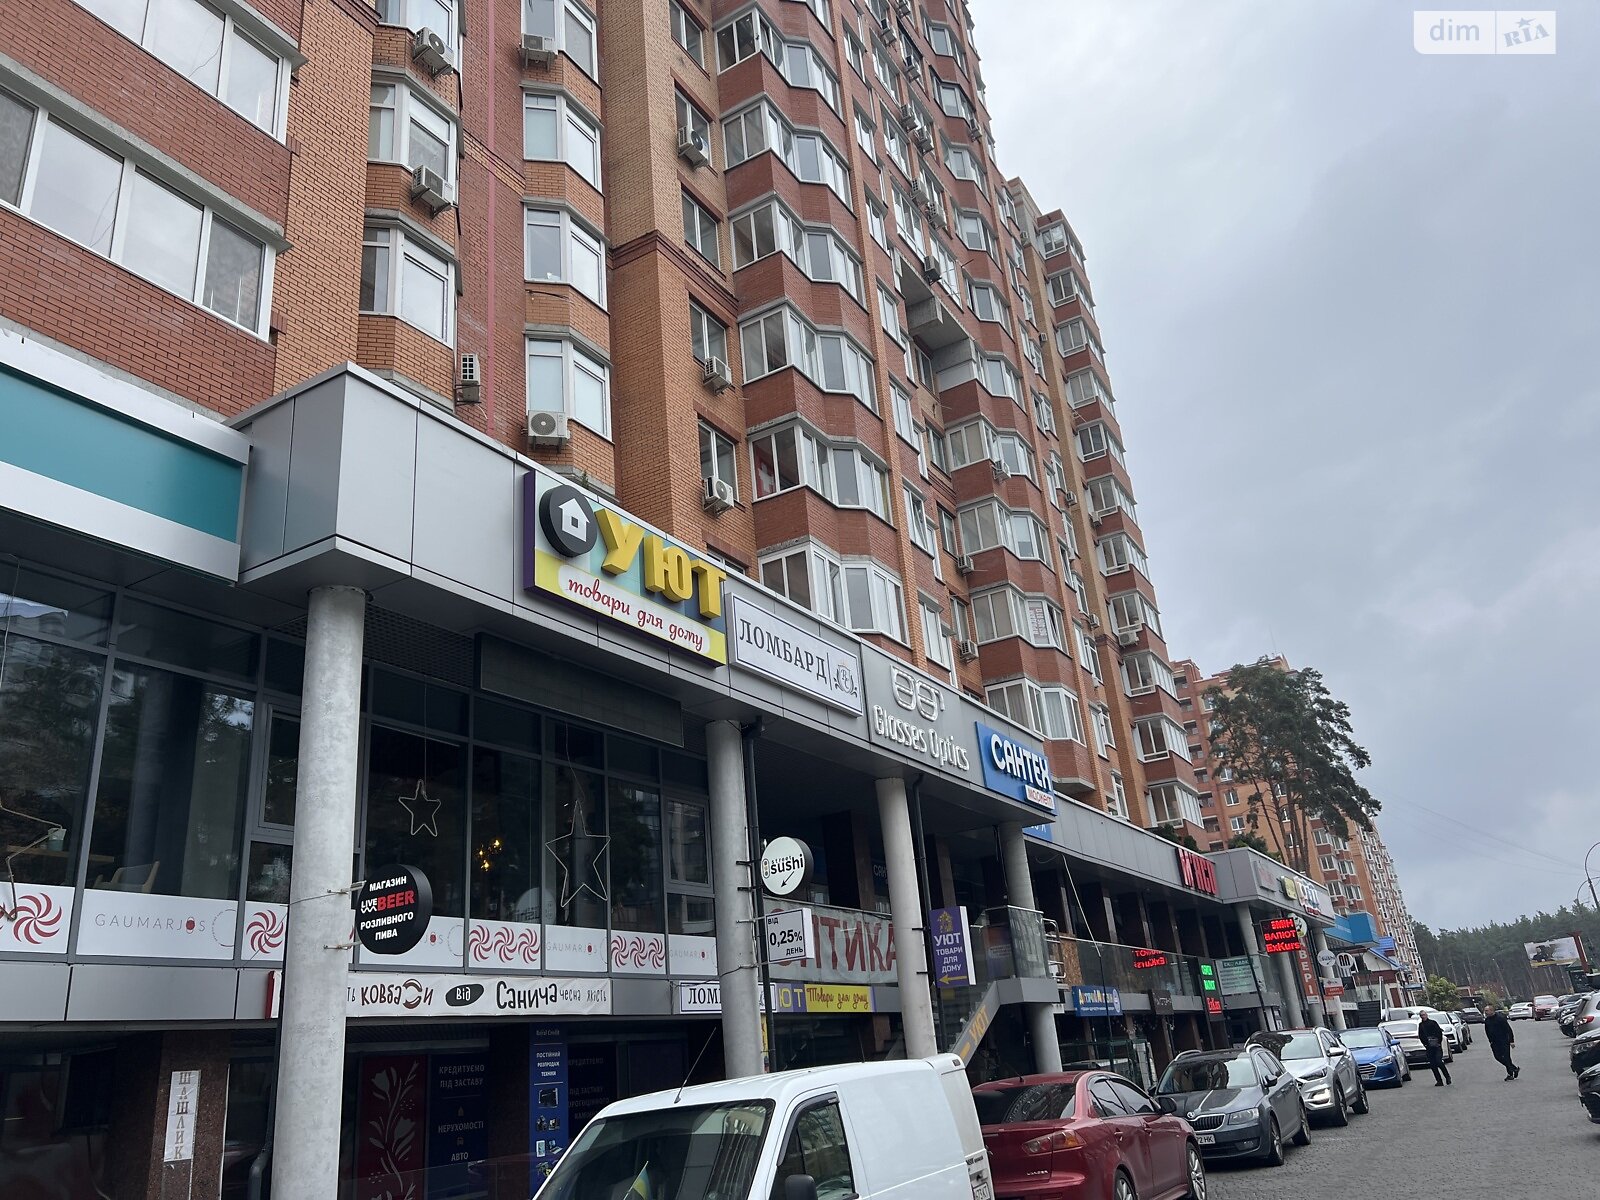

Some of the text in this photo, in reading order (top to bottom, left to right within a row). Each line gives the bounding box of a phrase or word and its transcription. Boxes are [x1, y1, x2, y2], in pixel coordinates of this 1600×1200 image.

[595, 508, 727, 620] УЮТ
[568, 576, 703, 652] товари для дому
[739, 618, 828, 683] ЛОМБАРД
[873, 704, 970, 771] Glasses Optics
[991, 734, 1052, 791] САНТЕХ
[771, 854, 804, 875] sushi
[369, 876, 407, 891] МАГАЗИН
[361, 890, 416, 911] LIVE BEER
[360, 912, 414, 931] РОЗЛИВНОГО
[767, 917, 779, 925] ВІД
[375, 929, 398, 941] ПИВА
[769, 929, 803, 947] 0,25%
[771, 908, 896, 971] ПТИКА
[934, 933, 961, 946] УЮТ
[786, 947, 804, 956] ДЕНЬ
[936, 946, 963, 956] ТОВАРИ
[1265, 942, 1301, 953] ExKurs
[942, 964, 962, 974] ДОМУ
[943, 956, 958, 965] ДЛЯ
[496, 981, 558, 1009] Санича
[559, 989, 581, 1001] чесна
[688, 987, 721, 1006] ЛОМ
[778, 988, 804, 1008] ЮТ
[440, 1077, 484, 1089] ПІД ЗАСТАВУ
[174, 1072, 192, 1160] ШАШЛИК
[438, 1121, 484, 1134] НЕРУХОМОСТІ
[451, 1152, 469, 1161] АВТО
